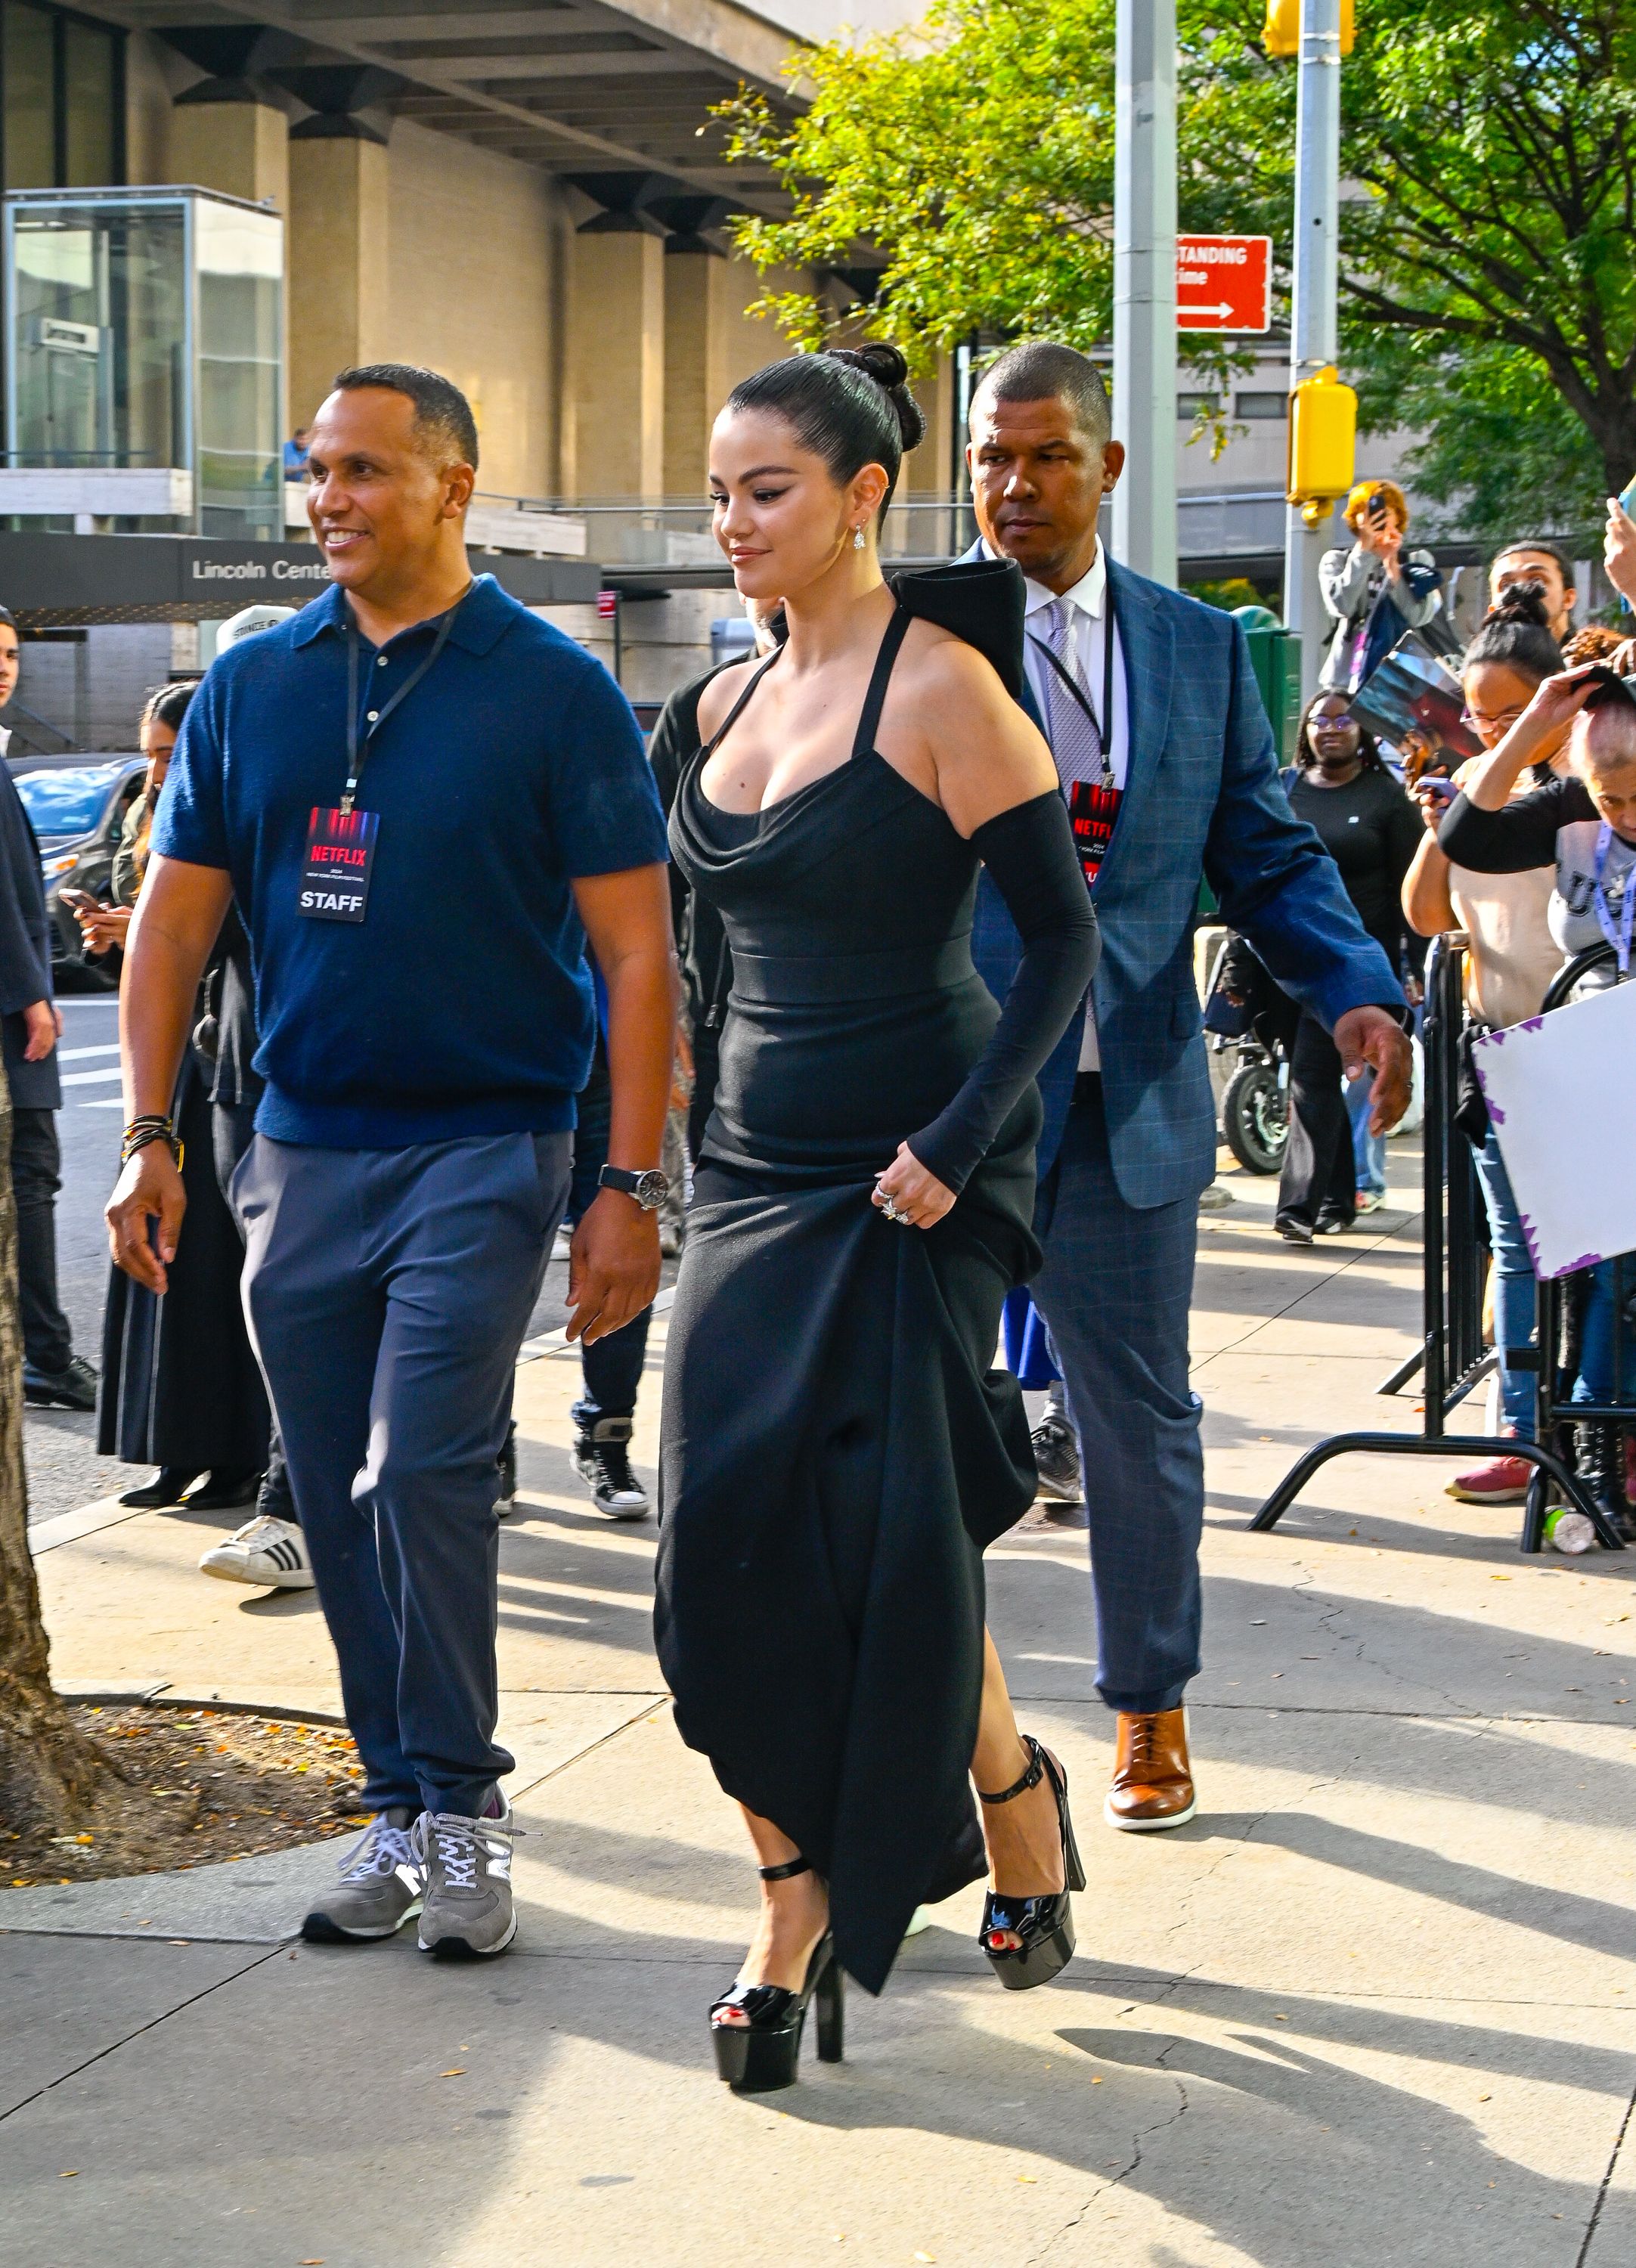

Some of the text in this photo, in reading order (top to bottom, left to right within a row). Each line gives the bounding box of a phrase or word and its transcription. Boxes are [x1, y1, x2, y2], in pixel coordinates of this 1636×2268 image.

[1176, 246, 1247, 265] TANDING
[1176, 267, 1208, 285] ime
[192, 560, 332, 579] Lincoln Cente
[1074, 818, 1111, 839] NETFL
[311, 845, 366, 866] NETFLIX
[300, 891, 363, 912] STAFF
